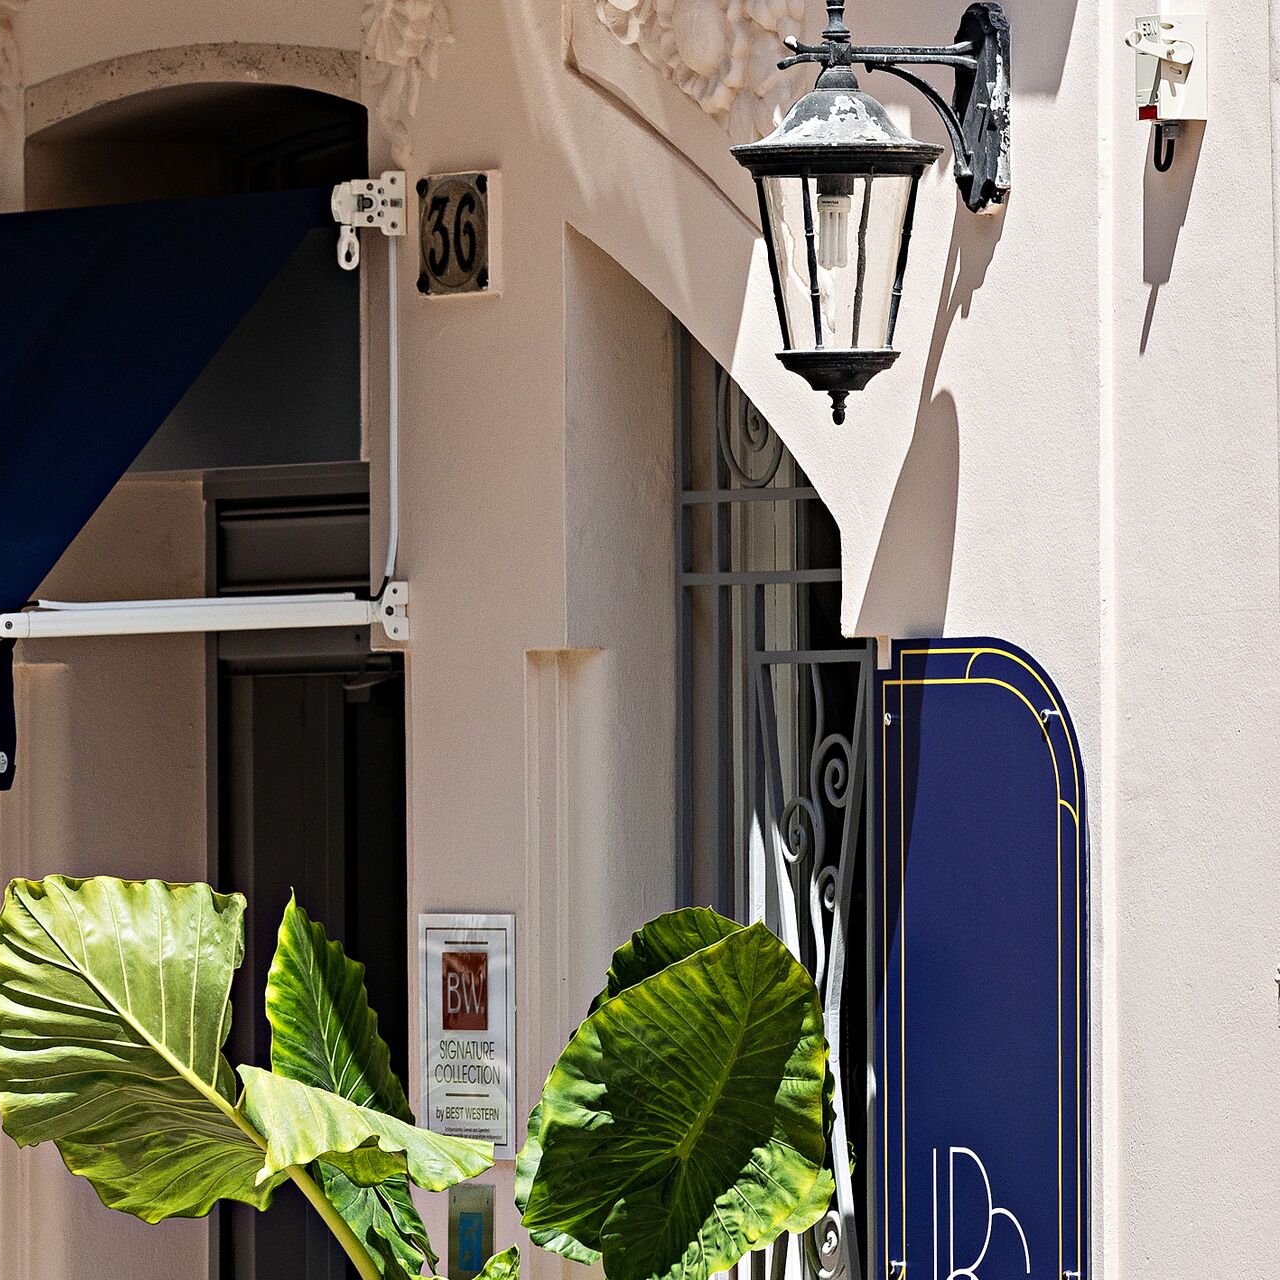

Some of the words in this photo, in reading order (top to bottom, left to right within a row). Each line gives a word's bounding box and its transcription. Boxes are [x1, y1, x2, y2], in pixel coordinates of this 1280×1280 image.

[427, 193, 476, 277] 36
[439, 1040, 495, 1060] SIGNATURE
[434, 1064, 500, 1085] COLLECTION
[436, 1106, 445, 1122] by
[445, 1107, 464, 1120] BEST
[465, 1107, 500, 1121] WESTERN
